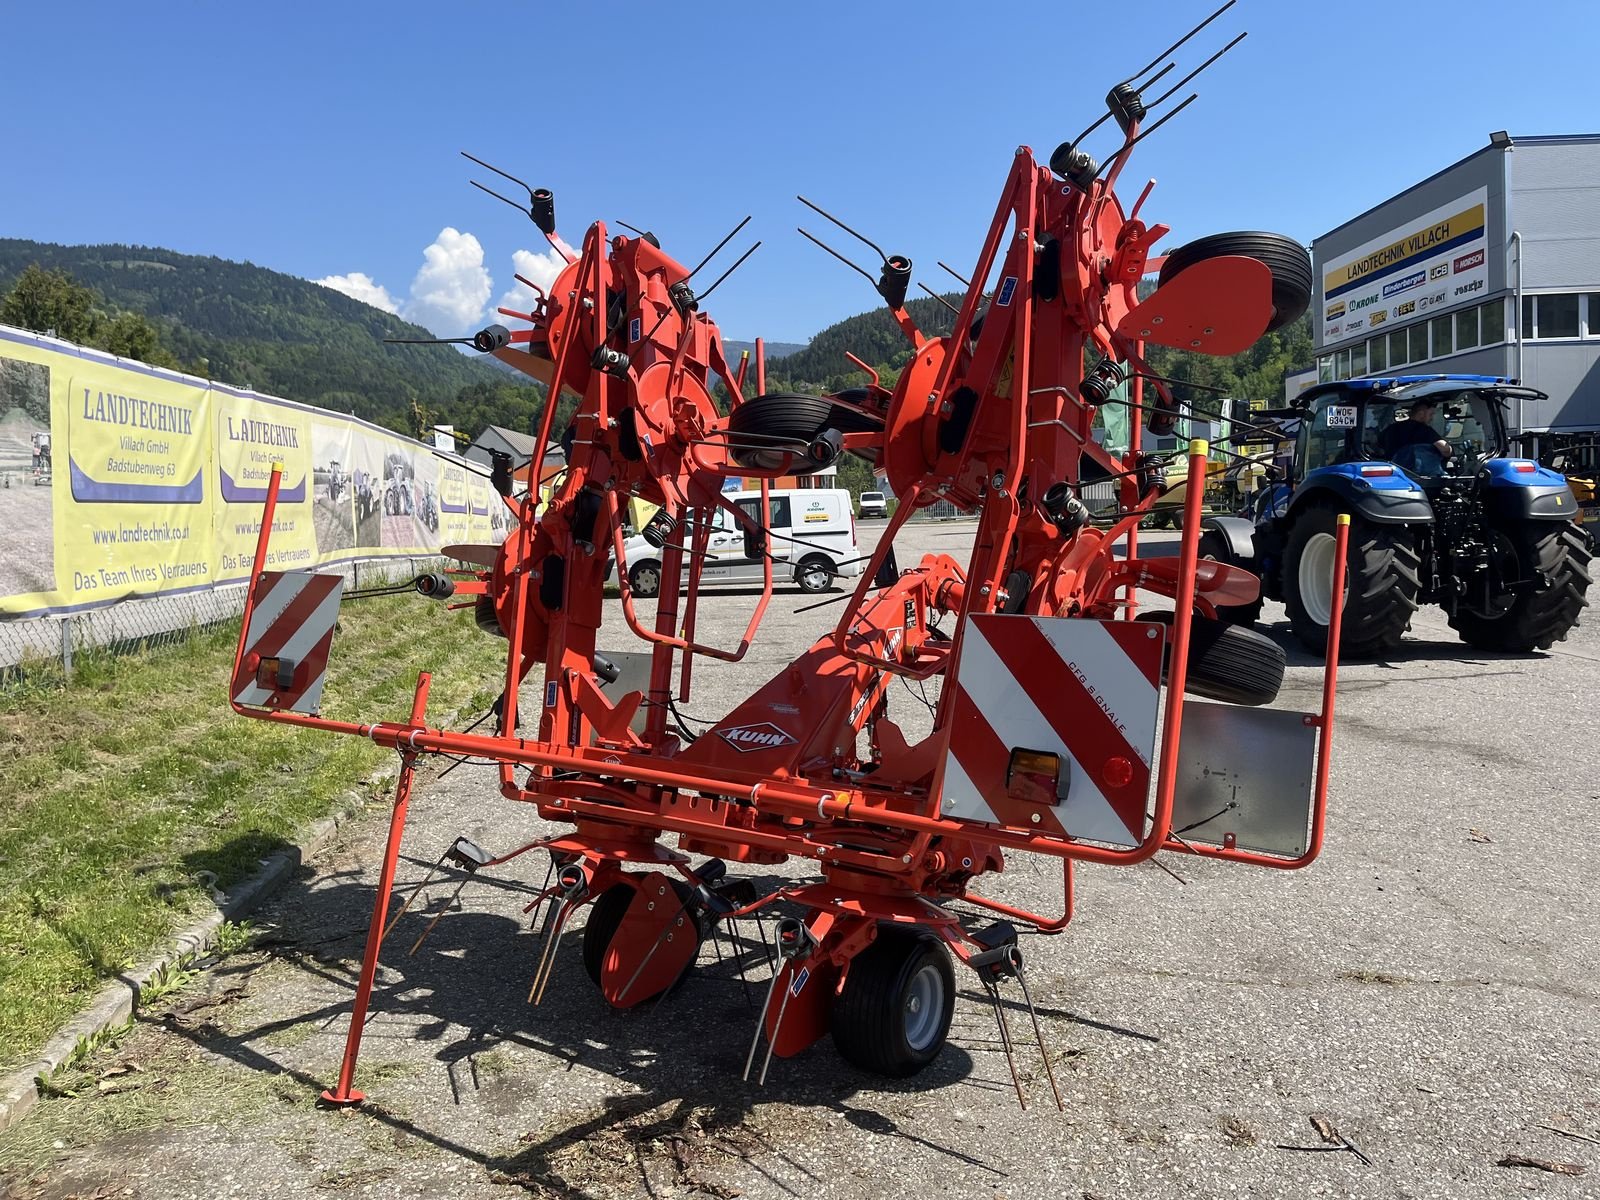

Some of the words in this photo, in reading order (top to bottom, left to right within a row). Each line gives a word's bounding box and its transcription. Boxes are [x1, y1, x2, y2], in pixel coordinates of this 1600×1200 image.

[1348, 243, 1405, 279] LANDTECHNIK
[1409, 223, 1449, 253] VILLACH
[1431, 264, 1448, 279] JCB
[1356, 294, 1379, 309] KRONE
[83, 388, 192, 435] LANDTECHNIK
[120, 436, 144, 452] Villach
[146, 440, 169, 454] GmbH
[107, 458, 165, 479] Badstubenweg
[166, 463, 176, 476] 63
[93, 522, 189, 544] www.landtechnik.co.at
[222, 555, 236, 569] Das
[74, 571, 97, 591] Das
[98, 567, 130, 587] Team
[130, 564, 157, 582] Ihres
[1068, 661, 1087, 684] CFG
[726, 729, 786, 745] KUHN
